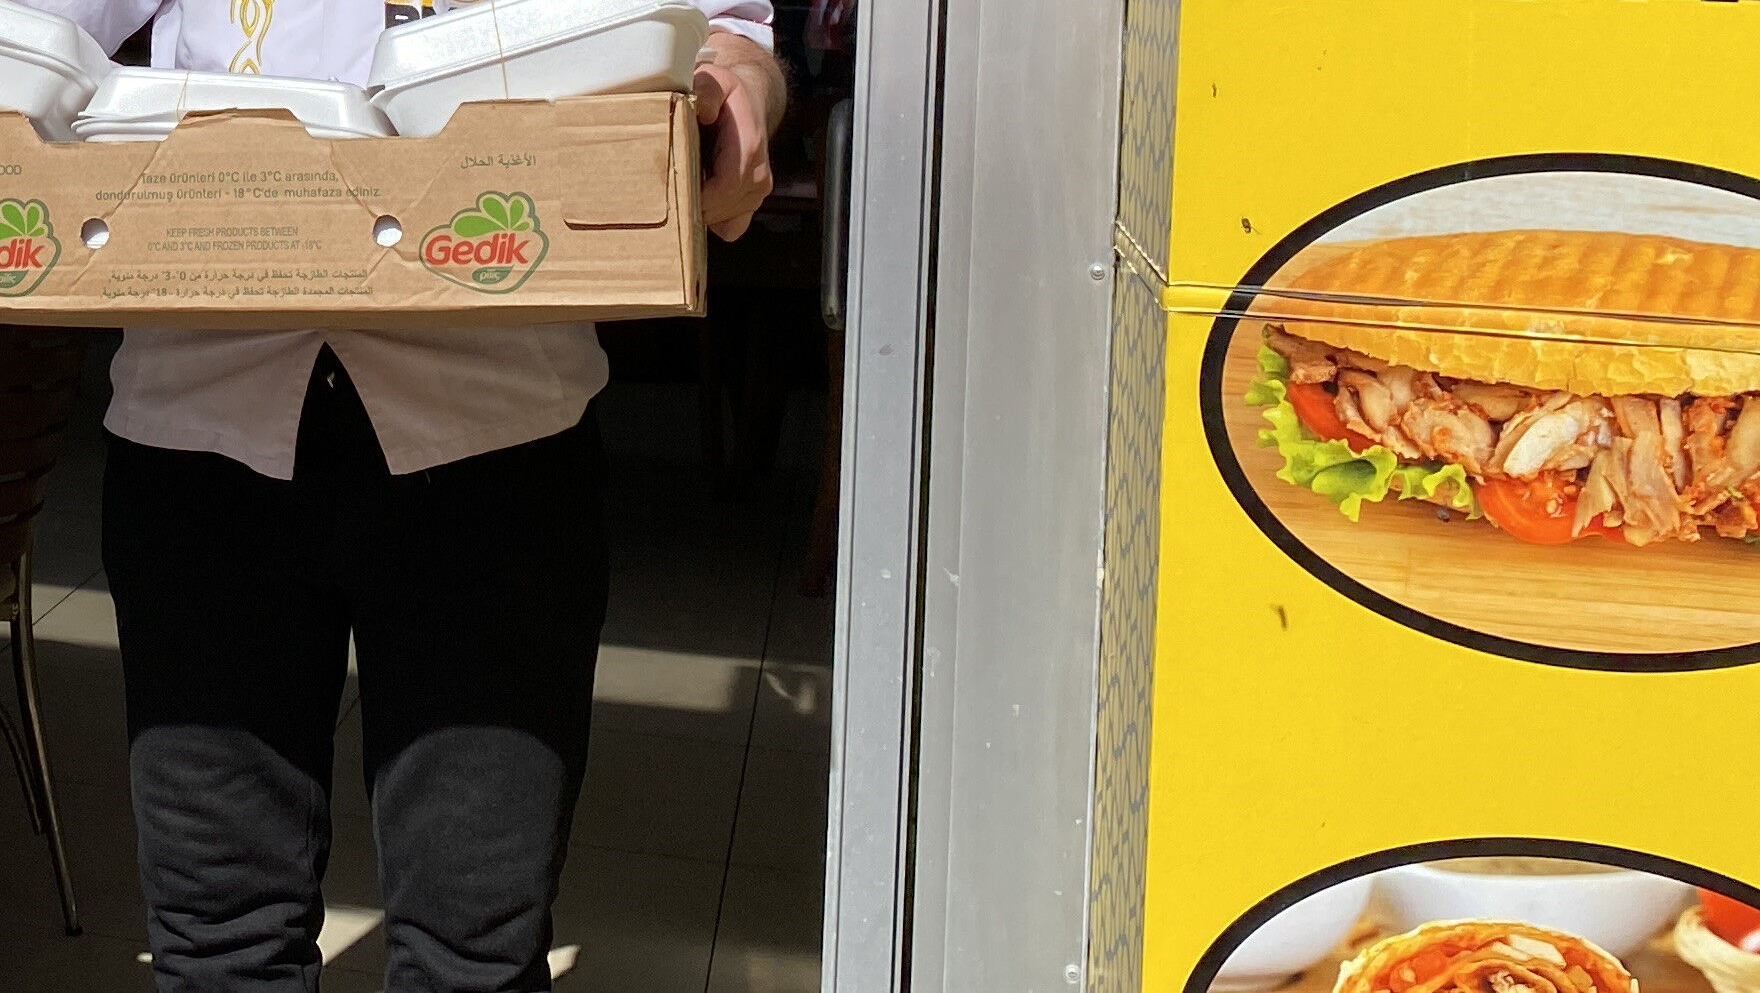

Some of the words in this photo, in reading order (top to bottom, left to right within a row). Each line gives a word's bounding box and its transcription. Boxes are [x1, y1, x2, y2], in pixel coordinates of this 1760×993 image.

[242, 171, 257, 183] ile
[166, 227, 187, 238] KEEP
[188, 227, 214, 237] FRESH
[215, 226, 258, 237] PRODUCTS
[260, 226, 298, 237] BETWEEN
[245, 240, 289, 250] PRODUCTS
[425, 233, 531, 266] Gedik
